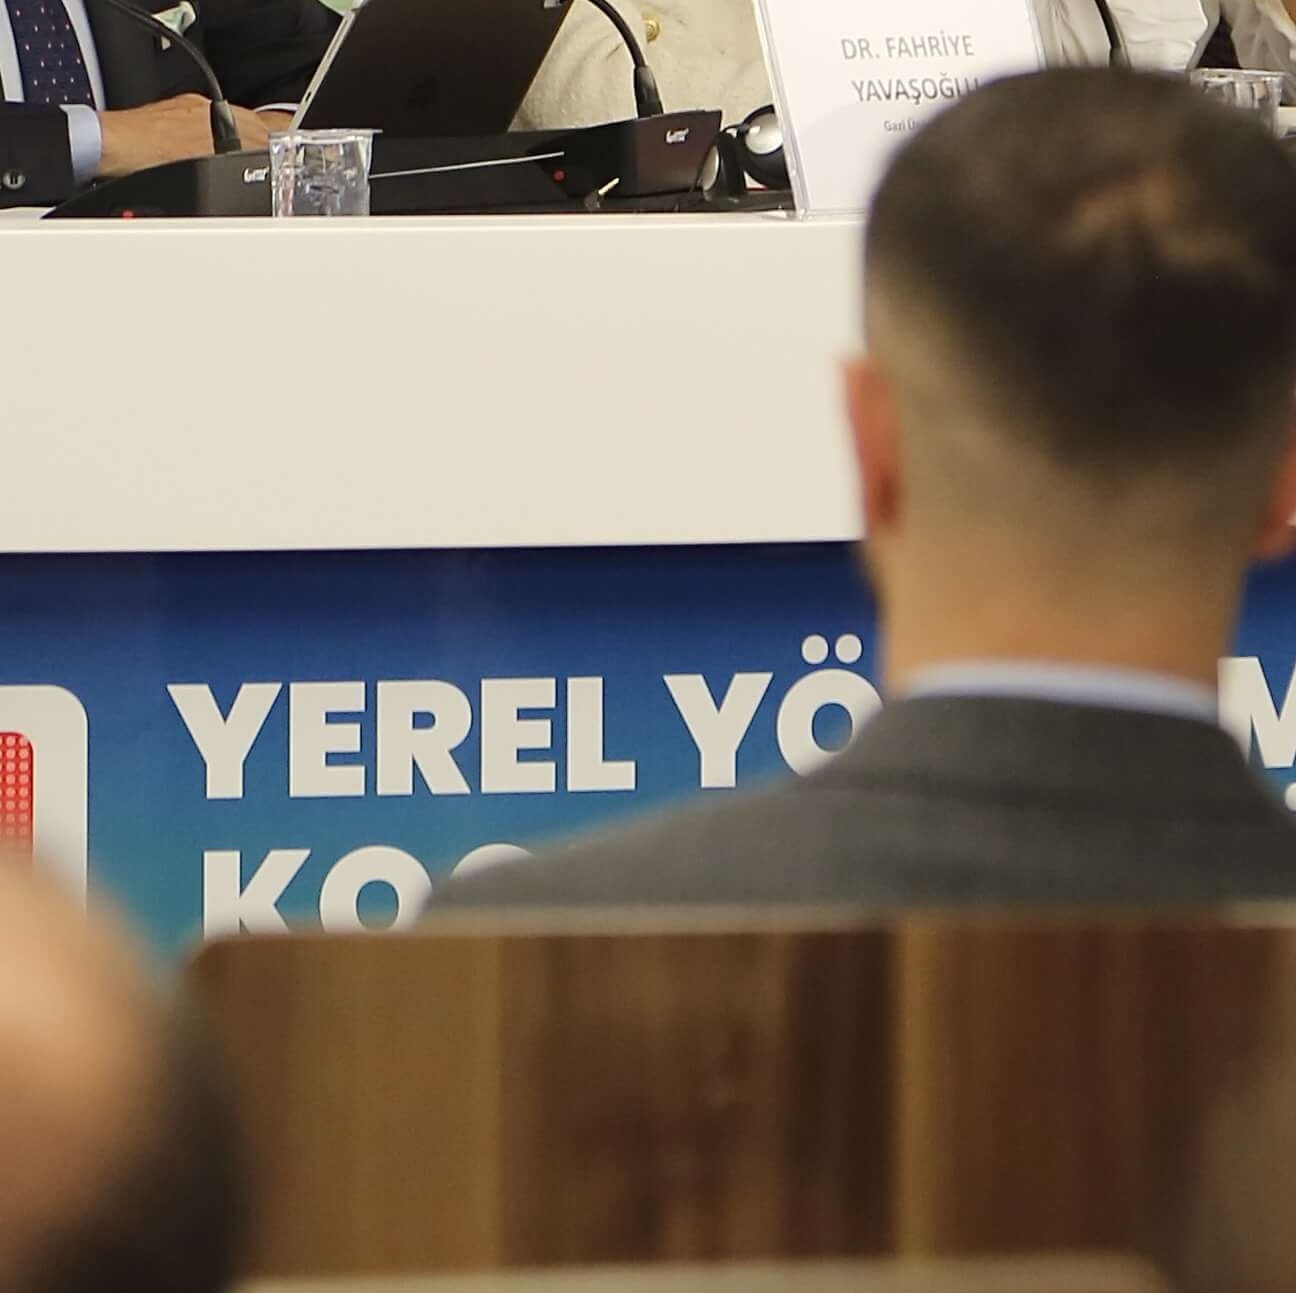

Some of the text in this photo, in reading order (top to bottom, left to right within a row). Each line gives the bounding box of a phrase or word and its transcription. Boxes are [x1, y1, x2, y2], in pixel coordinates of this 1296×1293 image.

[841, 30, 975, 60] DR. FAHRİYE
[165, 675, 637, 799] YEREL
